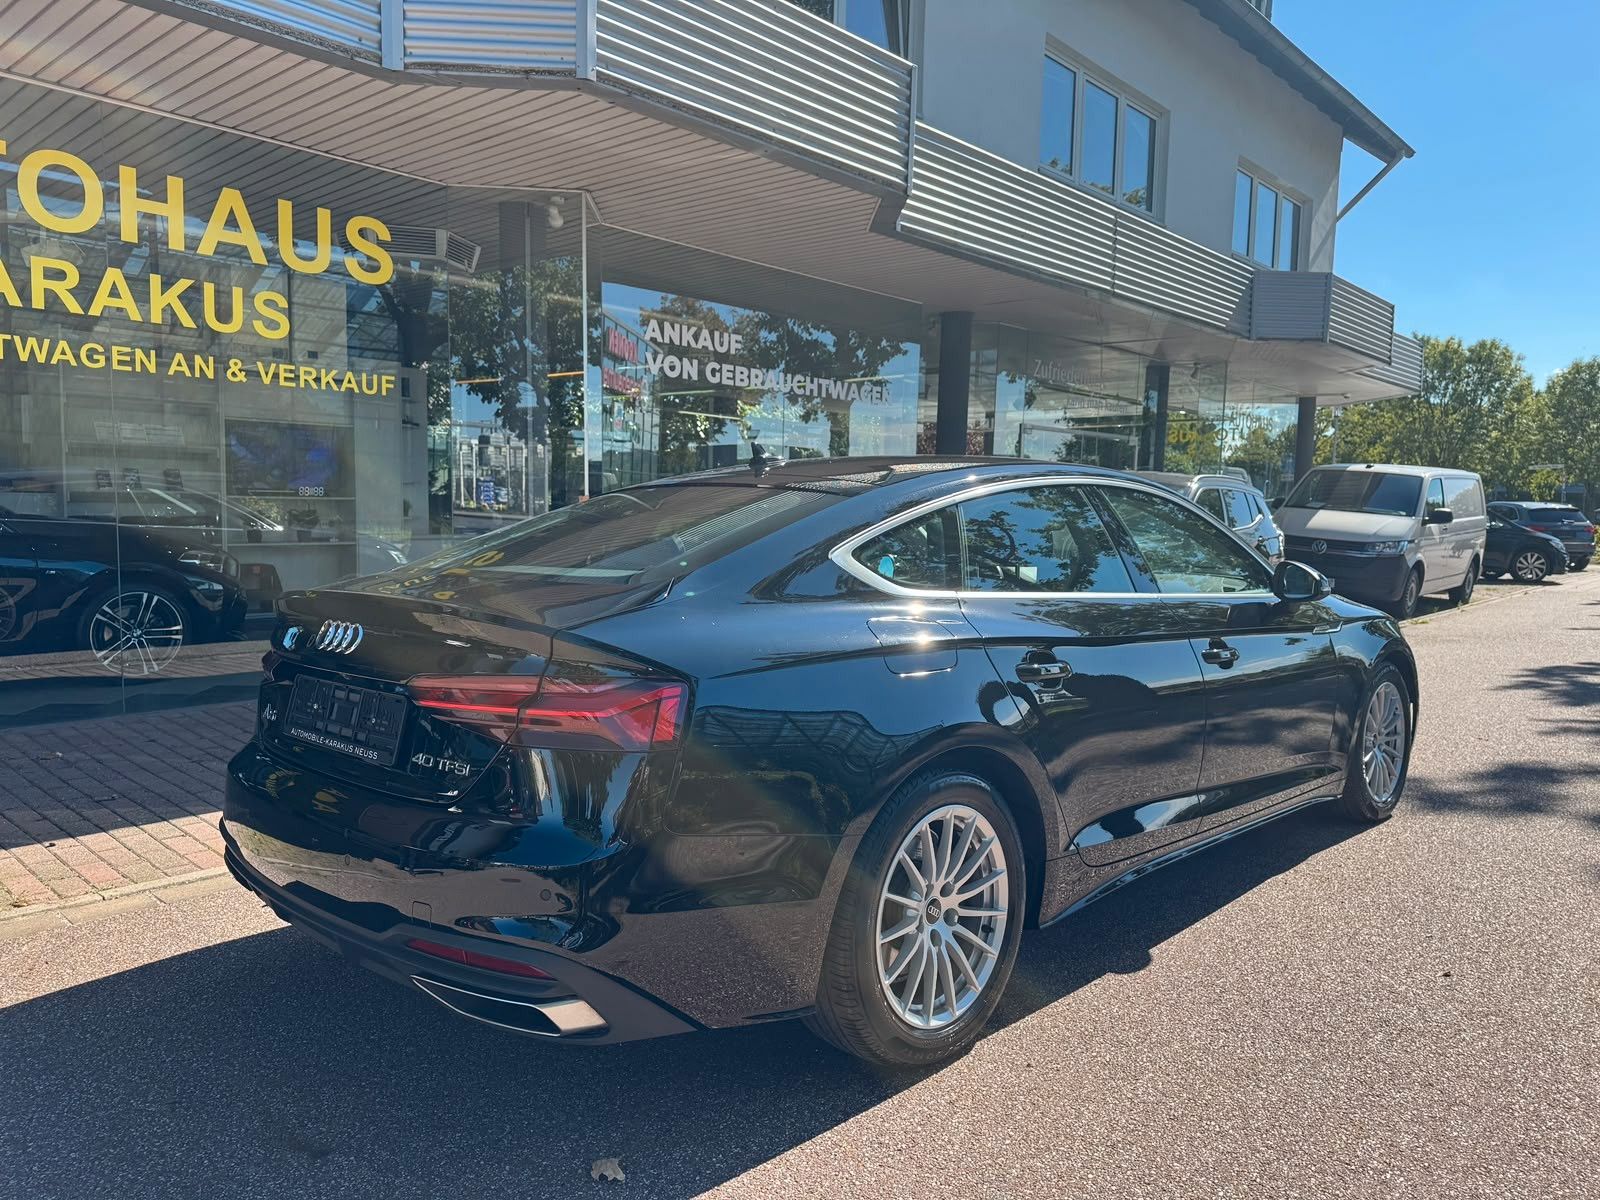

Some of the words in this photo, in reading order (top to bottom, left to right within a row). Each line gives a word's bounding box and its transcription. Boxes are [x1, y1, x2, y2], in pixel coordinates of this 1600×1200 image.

[0, 140, 394, 285] OHAUS
[645, 319, 743, 355] ANKAUF
[168, 352, 215, 380] AN
[226, 358, 248, 383] &
[256, 361, 396, 396] VERKAUF
[645, 354, 698, 381] VON
[705, 361, 893, 404] GEBRAUCHTWAGEN
[290, 727, 354, 753] AUTOMOBILE-KARAKUS
[354, 747, 378, 760] NEUSS
[412, 752, 433, 768] 40
[437, 757, 471, 777] TFSI
